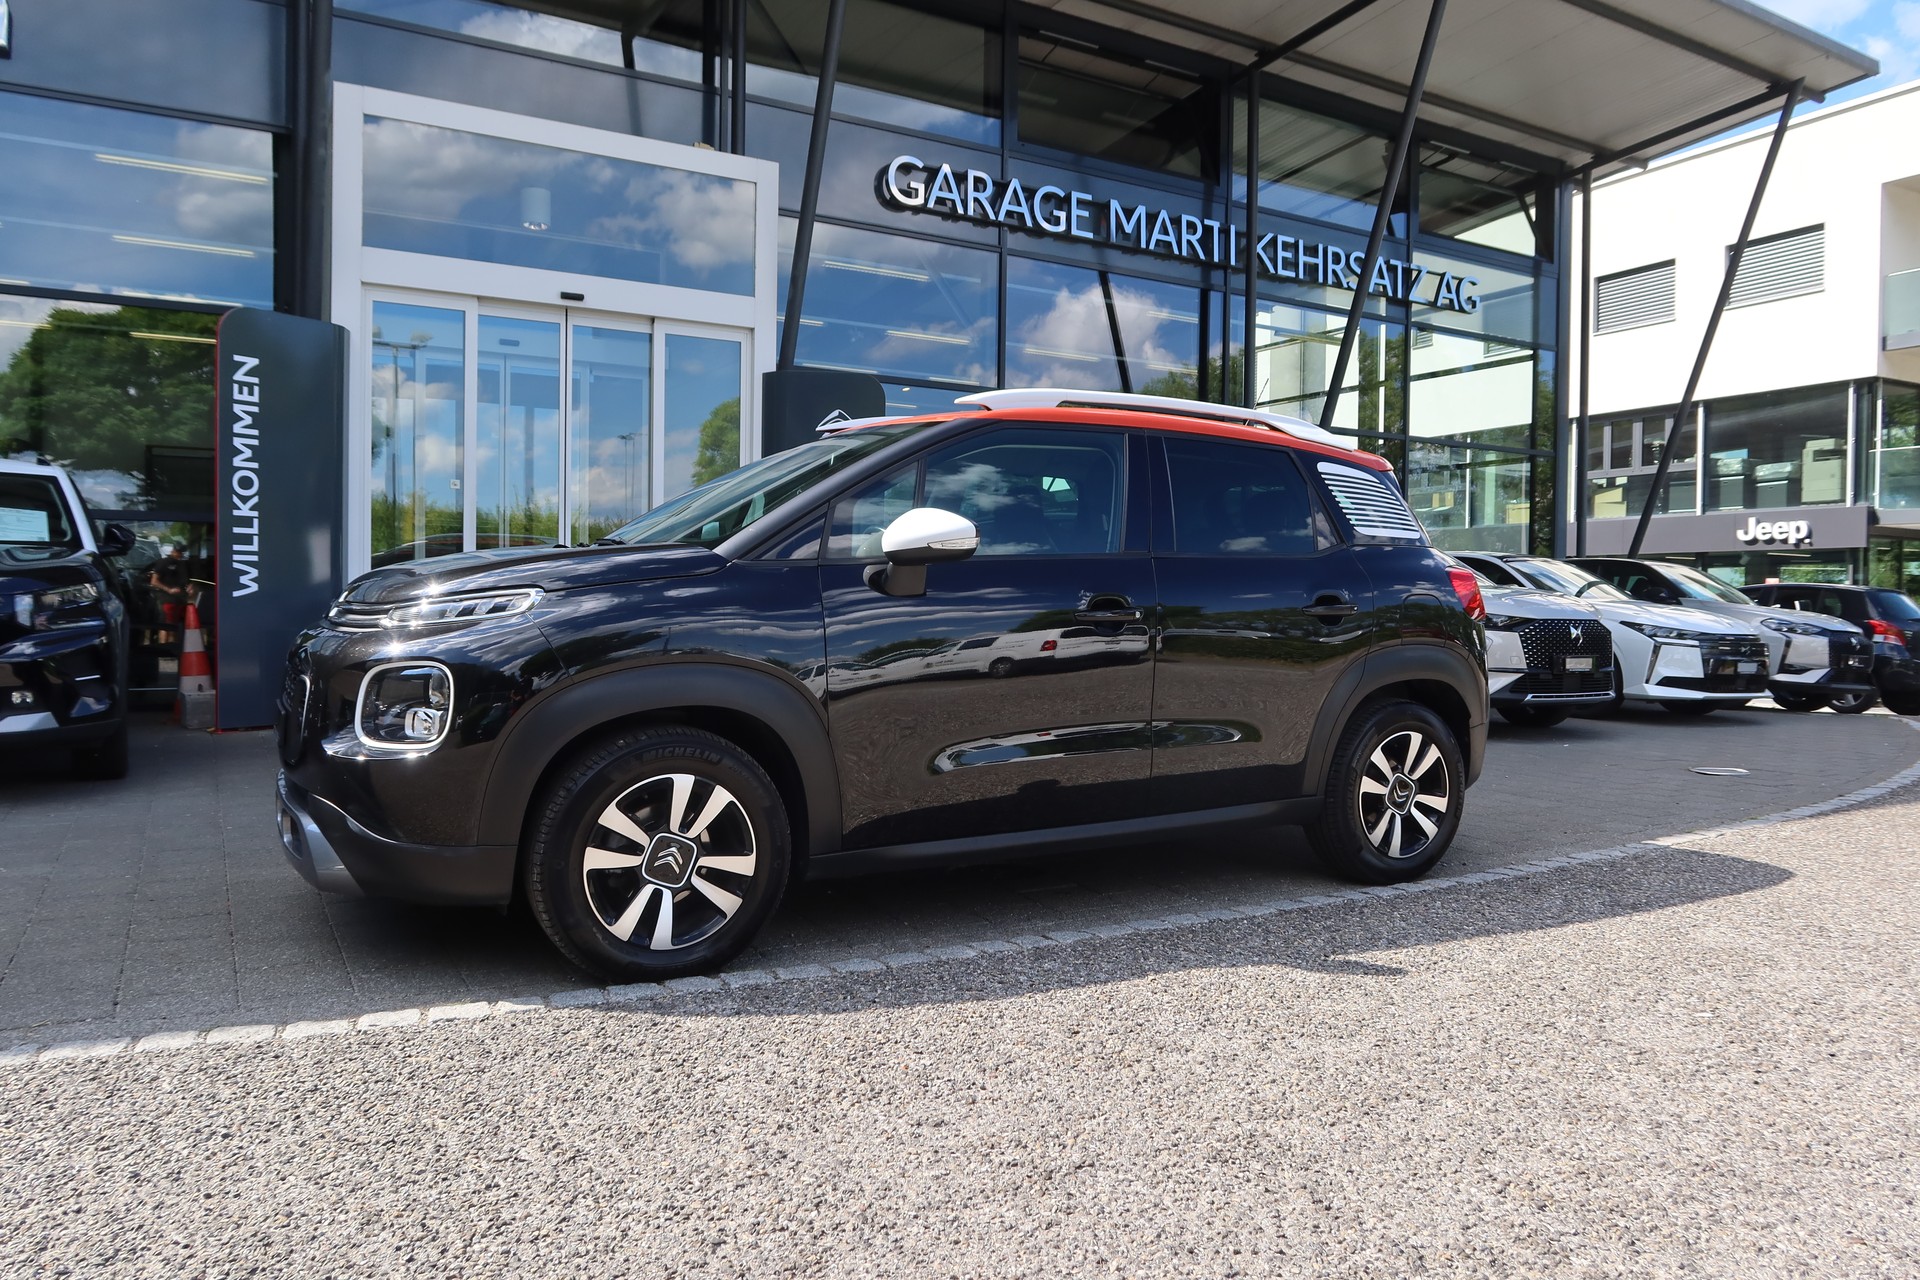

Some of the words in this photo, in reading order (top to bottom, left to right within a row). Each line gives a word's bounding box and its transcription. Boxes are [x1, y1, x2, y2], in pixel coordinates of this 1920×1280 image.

[887, 154, 1095, 239] GARAGE
[1110, 198, 1236, 266] MARTI
[1256, 231, 1431, 304] KEHRSATZ
[1437, 270, 1481, 314] AG
[232, 354, 260, 598] WILLKOMMEN
[641, 746, 721, 764] MICHELIN
